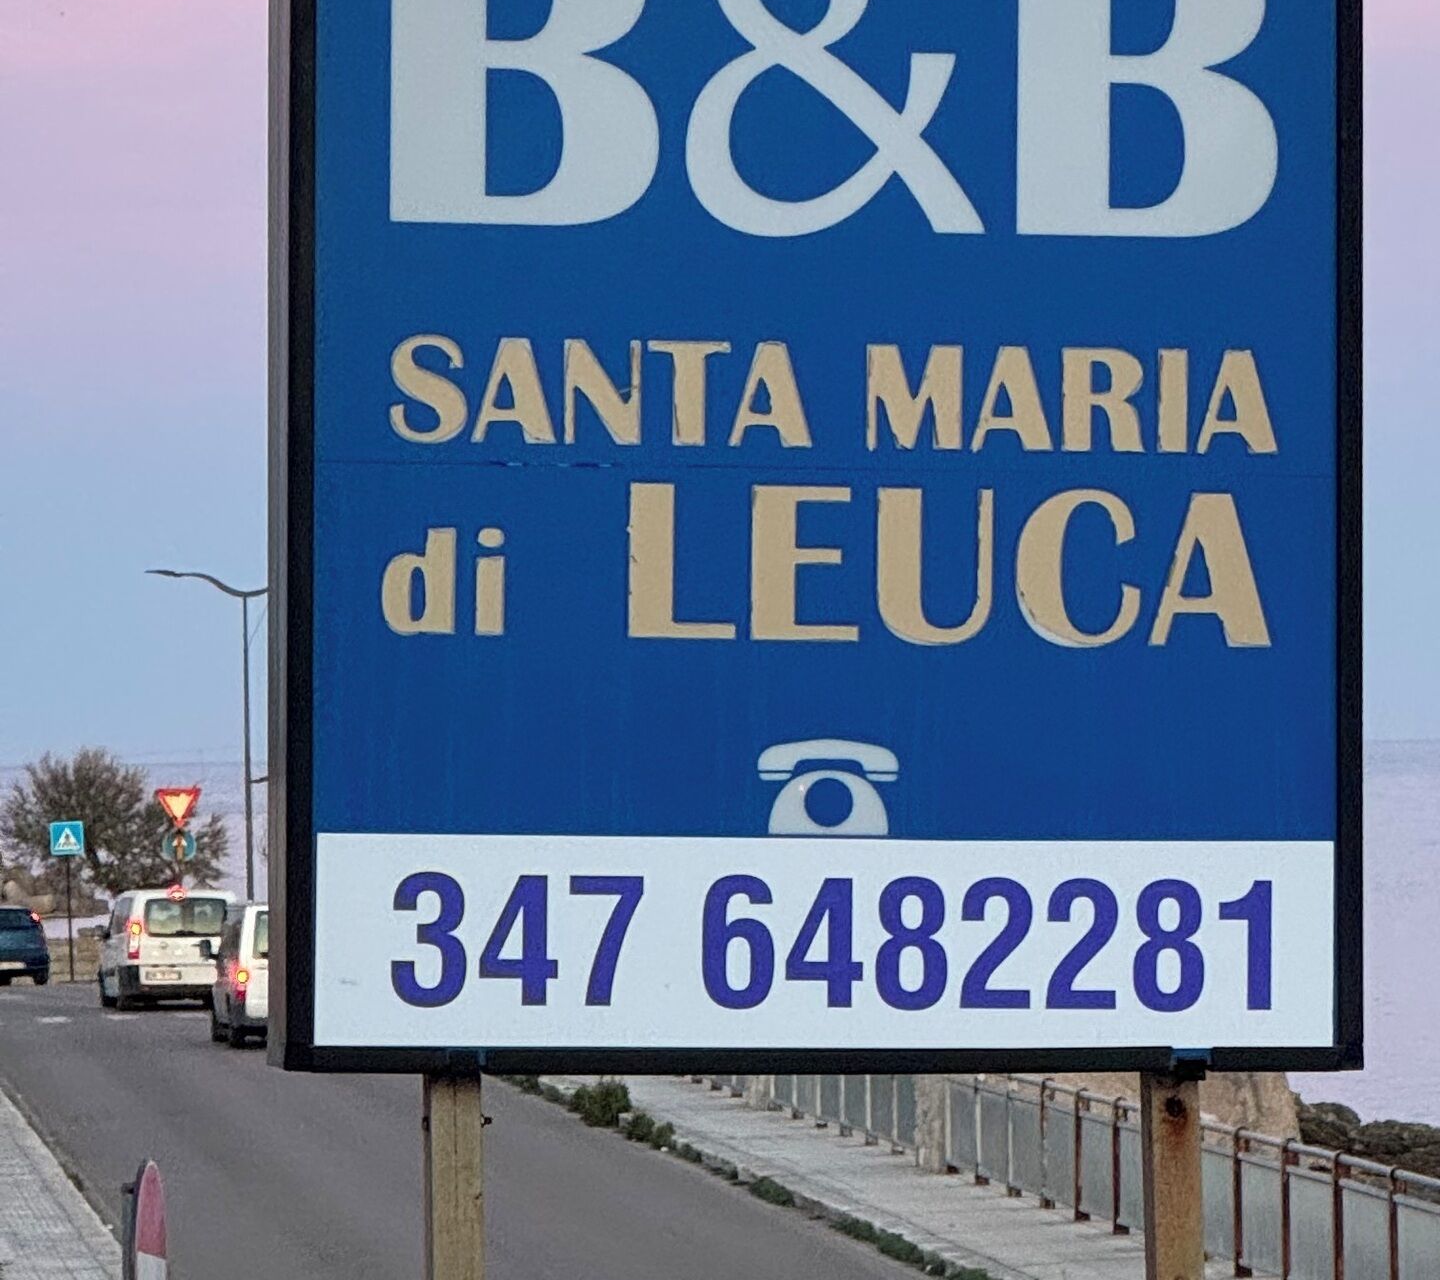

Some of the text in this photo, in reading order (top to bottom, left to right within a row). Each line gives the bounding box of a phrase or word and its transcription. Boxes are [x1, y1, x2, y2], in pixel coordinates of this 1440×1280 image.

[389, 335, 1279, 455] SANTA MARIA
[381, 482, 1273, 649] di LEUCA
[390, 871, 1275, 1013] 347 6482281
